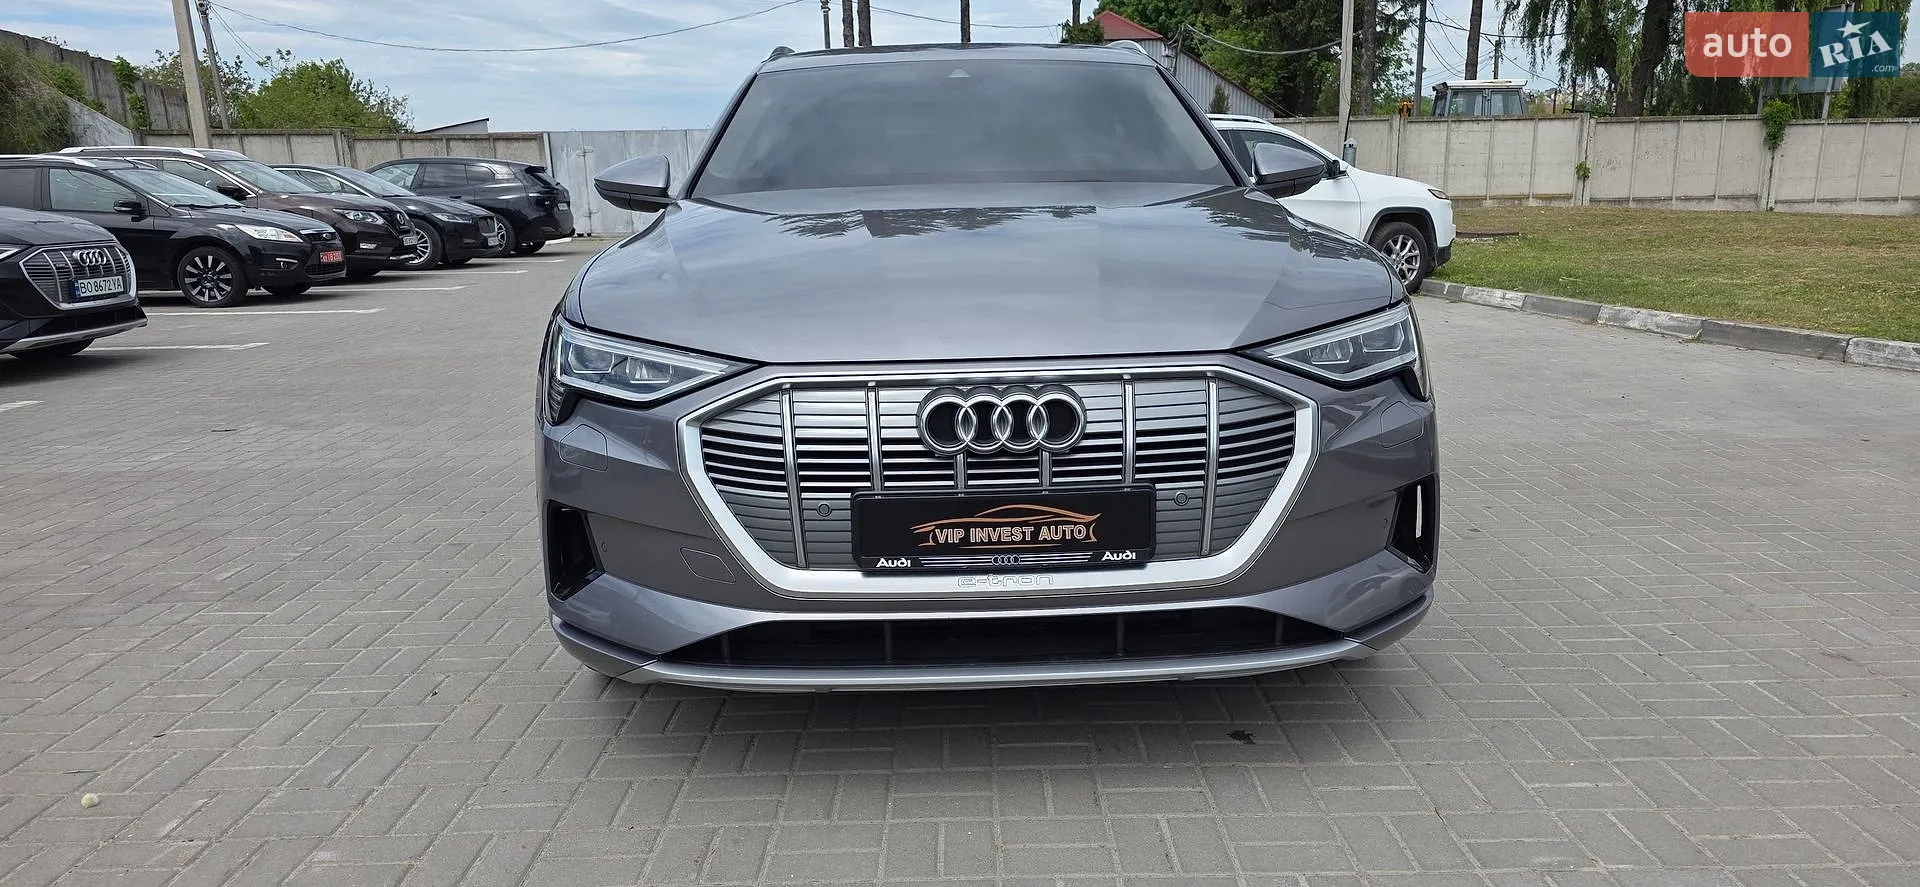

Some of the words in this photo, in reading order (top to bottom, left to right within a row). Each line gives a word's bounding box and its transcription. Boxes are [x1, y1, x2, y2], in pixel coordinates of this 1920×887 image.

[80, 282, 93, 294] BO
[94, 279, 112, 292] 8672
[112, 278, 122, 290] YA
[935, 527, 965, 544] VIP
[970, 526, 1034, 543] INVEST
[1038, 524, 1086, 541] AUTO
[876, 557, 911, 568] Audi
[1101, 550, 1136, 562] Audi
[957, 574, 1054, 588] e-tron
